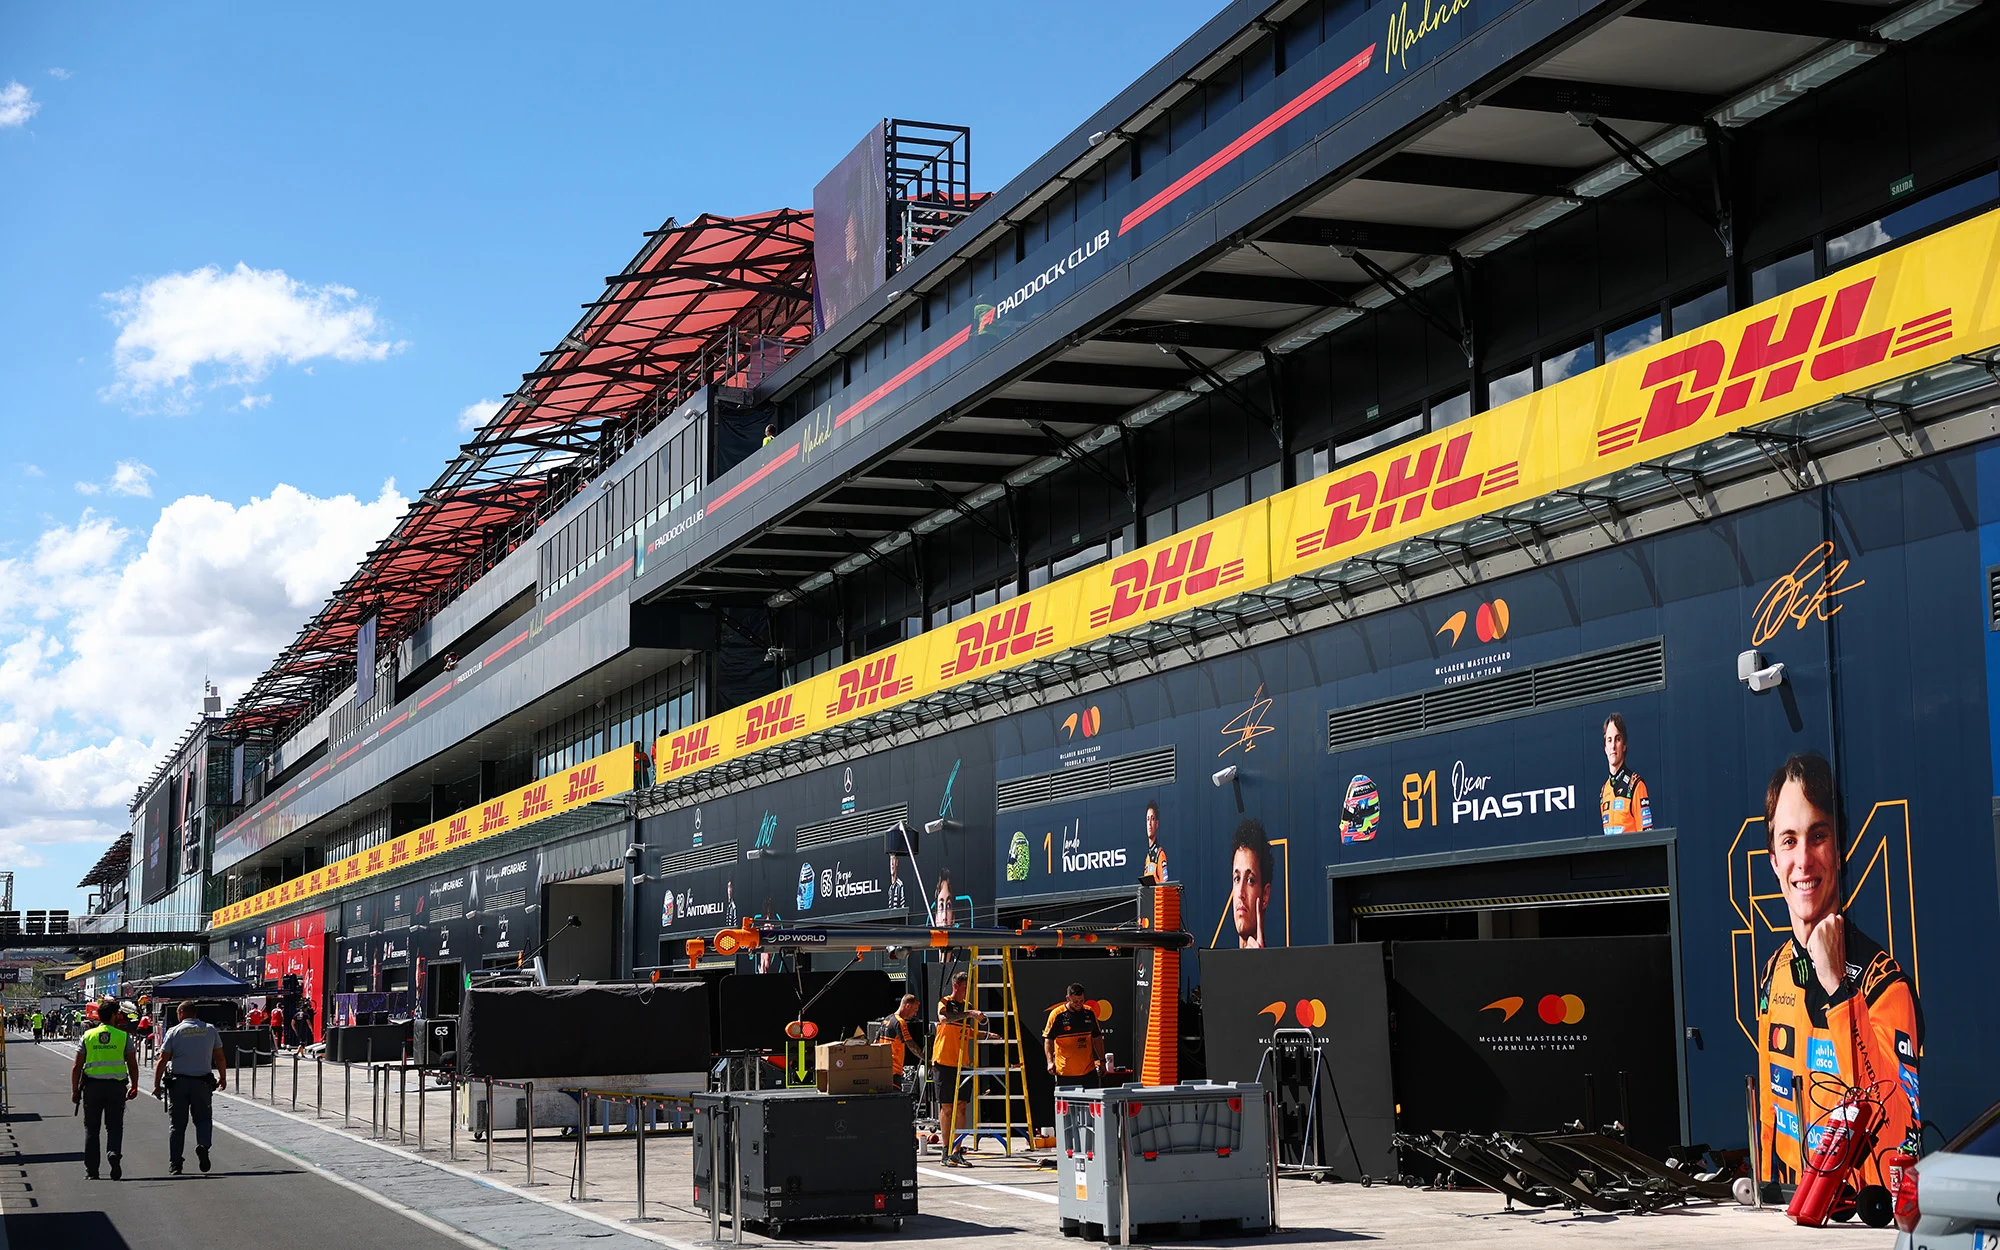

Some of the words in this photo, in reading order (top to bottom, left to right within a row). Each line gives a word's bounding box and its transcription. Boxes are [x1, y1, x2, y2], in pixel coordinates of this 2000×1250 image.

[1891, 179, 1913, 196] SALIDA
[996, 258, 1066, 319] PADDOCK
[1068, 229, 1110, 269] CLUB
[1638, 276, 1896, 443] DHL
[802, 404, 832, 463] Madrid
[1322, 431, 1484, 550] DHL
[654, 521, 686, 550] PADDOCK
[685, 508, 704, 529] CLUB
[1109, 531, 1220, 623] DHL
[955, 602, 1037, 675] DHL
[1435, 662, 1465, 675] McLAREN
[1467, 651, 1511, 668] MASTERCARD
[1444, 672, 1475, 685] FORMULA
[1484, 666, 1502, 676] TEAM
[837, 653, 900, 715] DHL
[745, 694, 795, 745] DHL
[671, 725, 711, 771] DHL
[522, 784, 548, 818] DHL
[568, 764, 598, 802] DHL
[1402, 770, 1437, 830] 81
[1451, 760, 1491, 802] Oscar
[482, 801, 504, 832] DHL
[1452, 785, 1575, 824] PIASTRI
[449, 816, 467, 843] DHL
[1043, 832, 1052, 874] 1
[1063, 848, 1127, 873] NORRIS
[821, 868, 833, 897] 63
[835, 879, 882, 898] RUSSELL
[686, 902, 724, 917] ANTONELLI
[778, 934, 791, 942] DP
[792, 934, 826, 942] WORLD
[1772, 991, 1797, 1007] Android
[434, 1026, 449, 1036] 63
[1816, 1058, 1833, 1069] cisco
